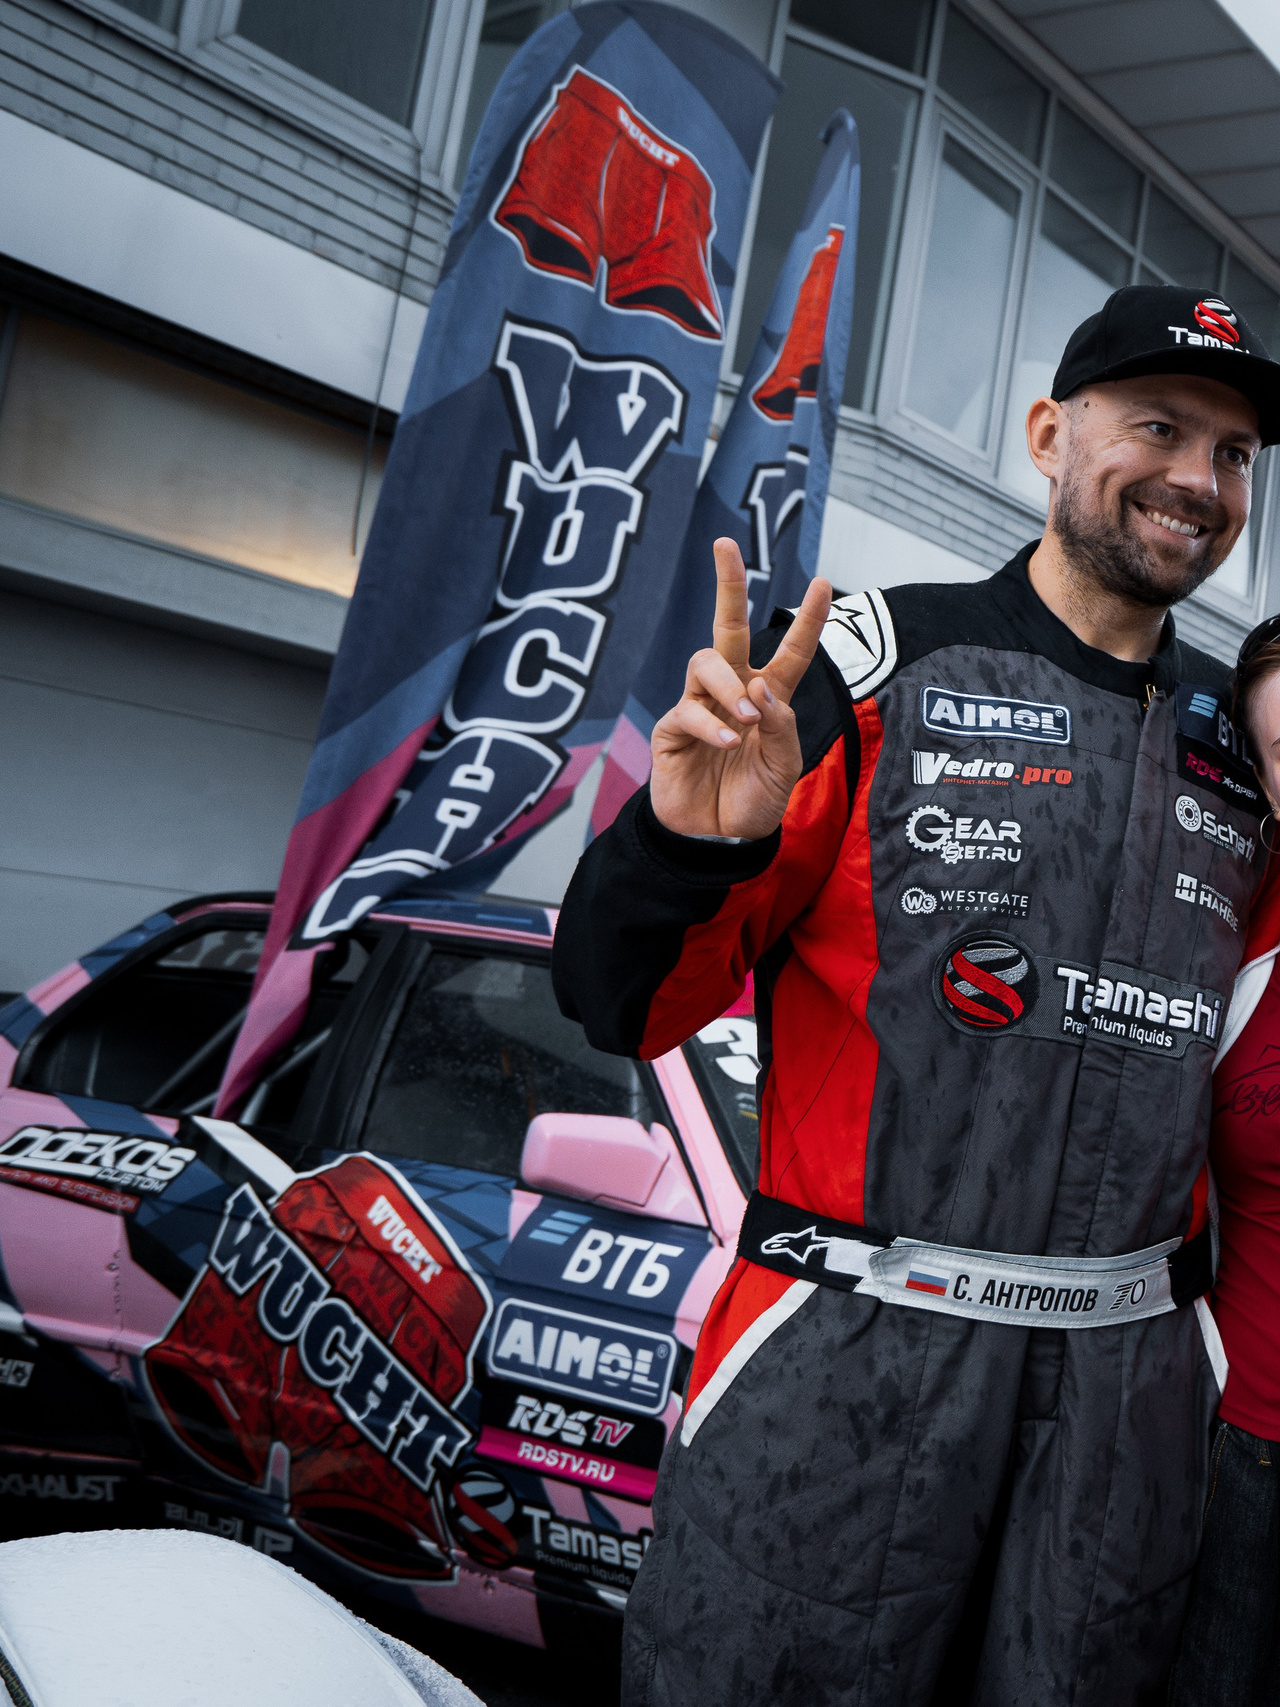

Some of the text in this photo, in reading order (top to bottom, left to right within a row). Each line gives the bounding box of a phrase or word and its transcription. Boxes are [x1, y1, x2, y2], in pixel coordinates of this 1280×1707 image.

[913, 750, 1072, 786] Vedro.pro
[942, 777, 1010, 787] ИНТЕРНЕТ-МАГАЗИН
[1185, 751, 1224, 784] RDS
[905, 804, 1022, 853] GEAR
[939, 905, 1027, 918] AUTOSERVICE
[940, 889, 1029, 908] WESTGATE
[1057, 966, 1221, 1039] Tamashi
[1128, 1023, 1174, 1048] liquids
[96, 1166, 169, 1194] CUSTOM
[366, 1194, 443, 1284] WUCHT
[561, 1228, 685, 1299] ВТБ
[953, 1274, 973, 1302] С.
[979, 1278, 1099, 1312] АНТРОПОВ
[208, 1182, 474, 1493] WUCHT
[517, 1441, 615, 1482] RDSTV.RU
[535, 1550, 633, 1586] Premium liquids
